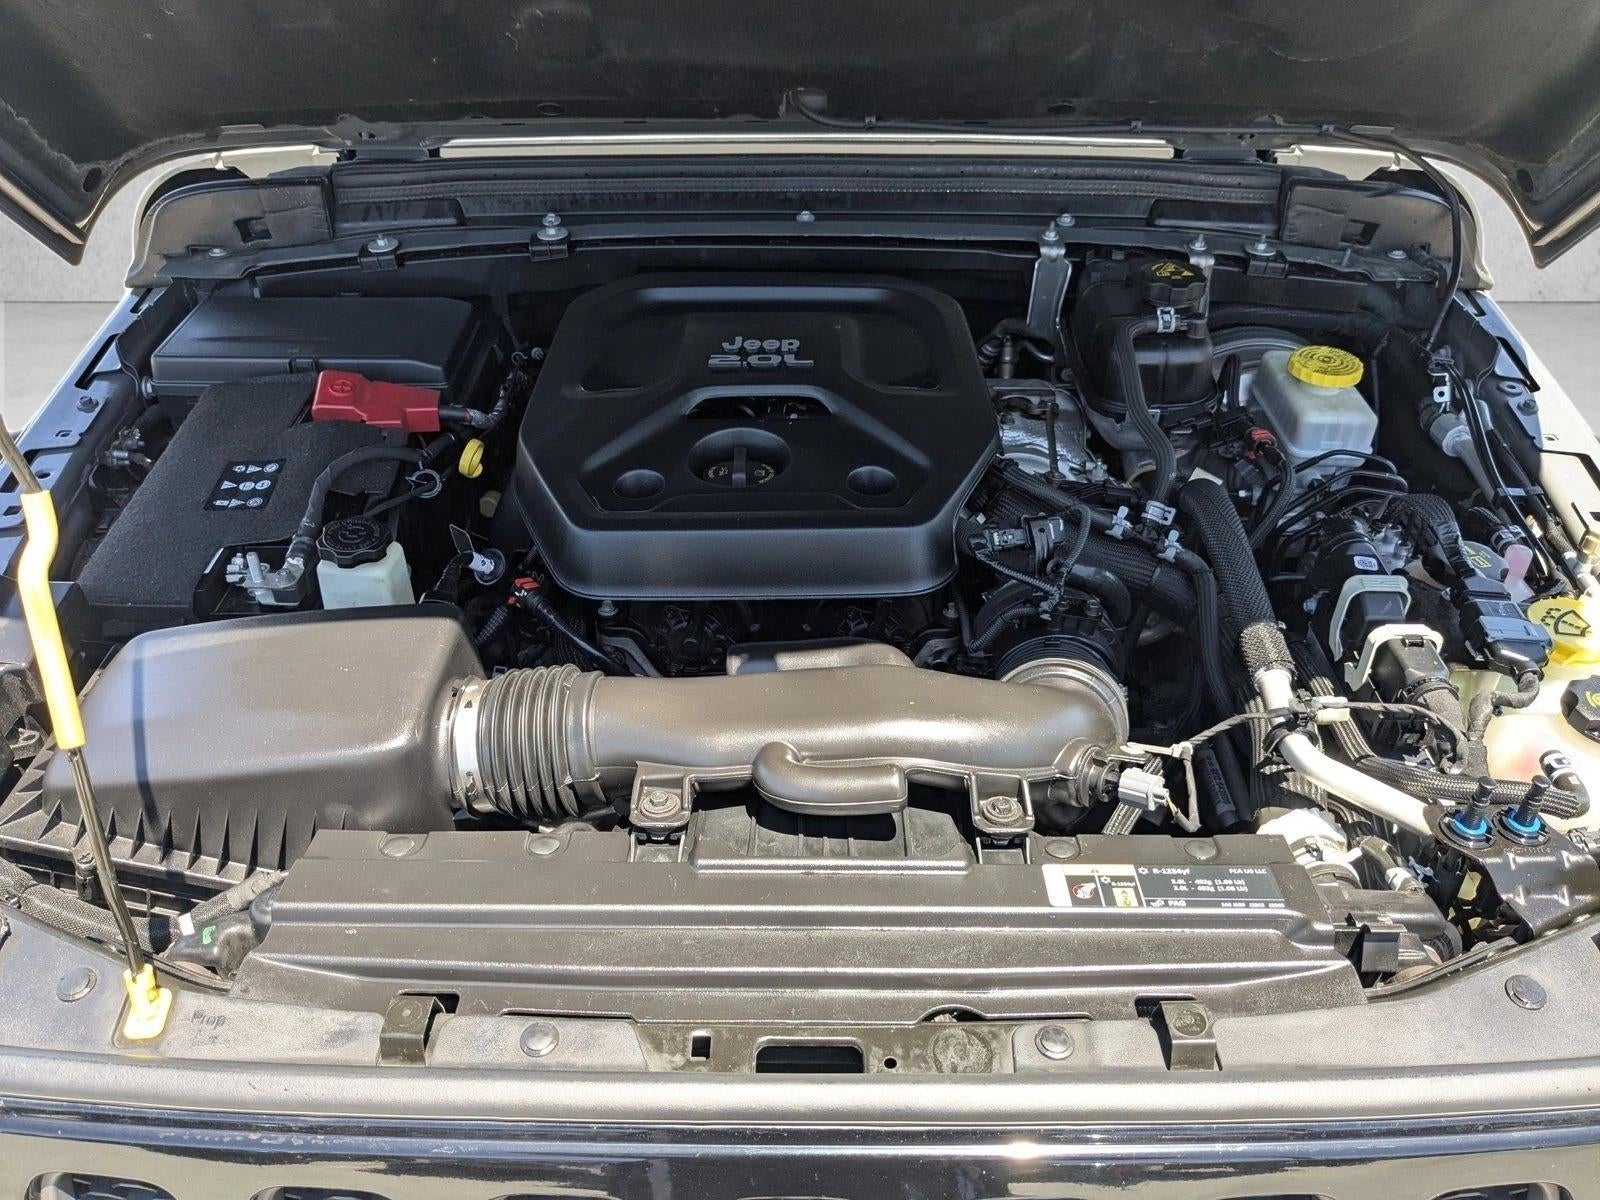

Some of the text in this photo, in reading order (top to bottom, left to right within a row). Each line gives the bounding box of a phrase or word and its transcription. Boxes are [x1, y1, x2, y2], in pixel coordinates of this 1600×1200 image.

[721, 336, 800, 352] Jeep
[708, 354, 815, 367] 2.0L
[1152, 868, 1190, 876] R-1234yf
[190, 1010, 227, 1030] Prop
